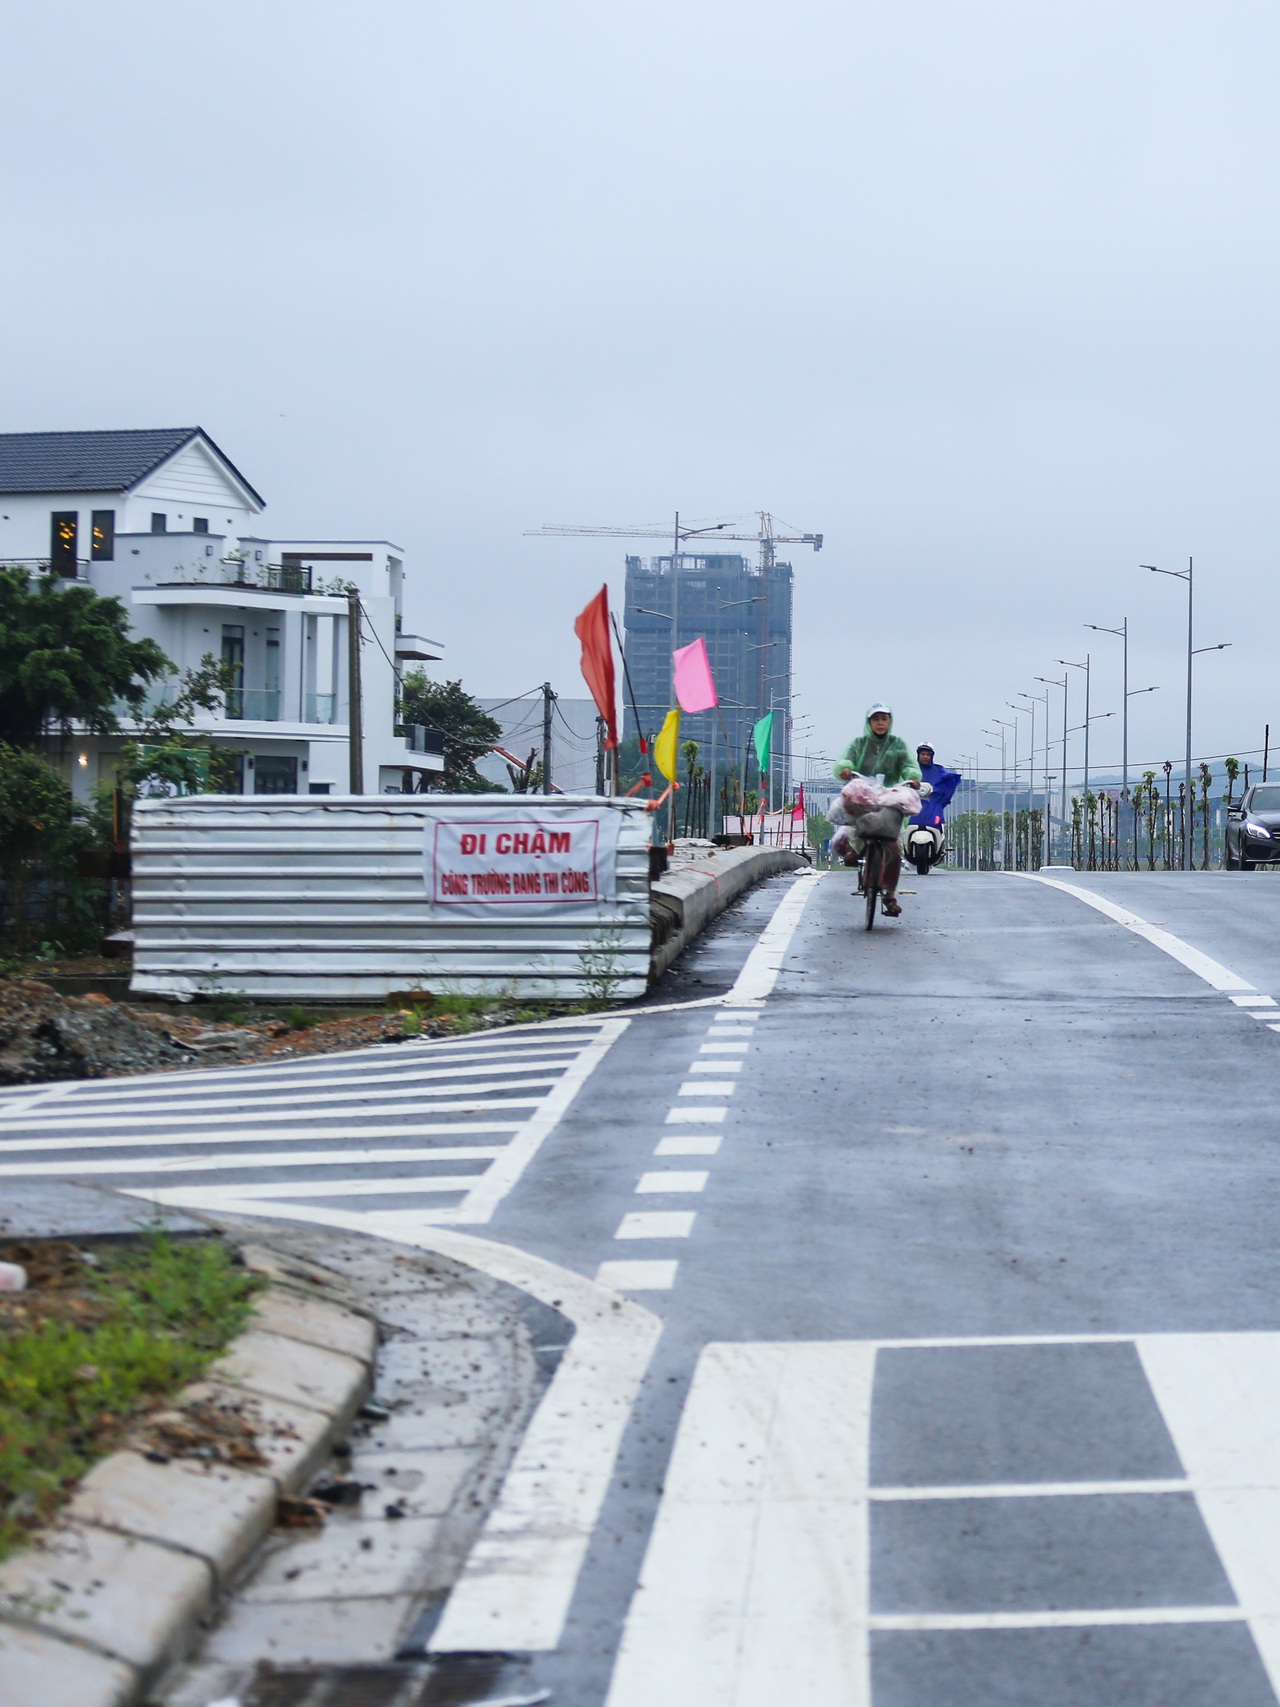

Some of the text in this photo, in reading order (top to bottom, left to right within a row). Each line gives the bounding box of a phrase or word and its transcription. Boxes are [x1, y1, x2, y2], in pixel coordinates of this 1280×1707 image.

[460, 828, 571, 859] ĐI CHẬM
[513, 872, 541, 895] ĐANG
[543, 872, 559, 894] THI
